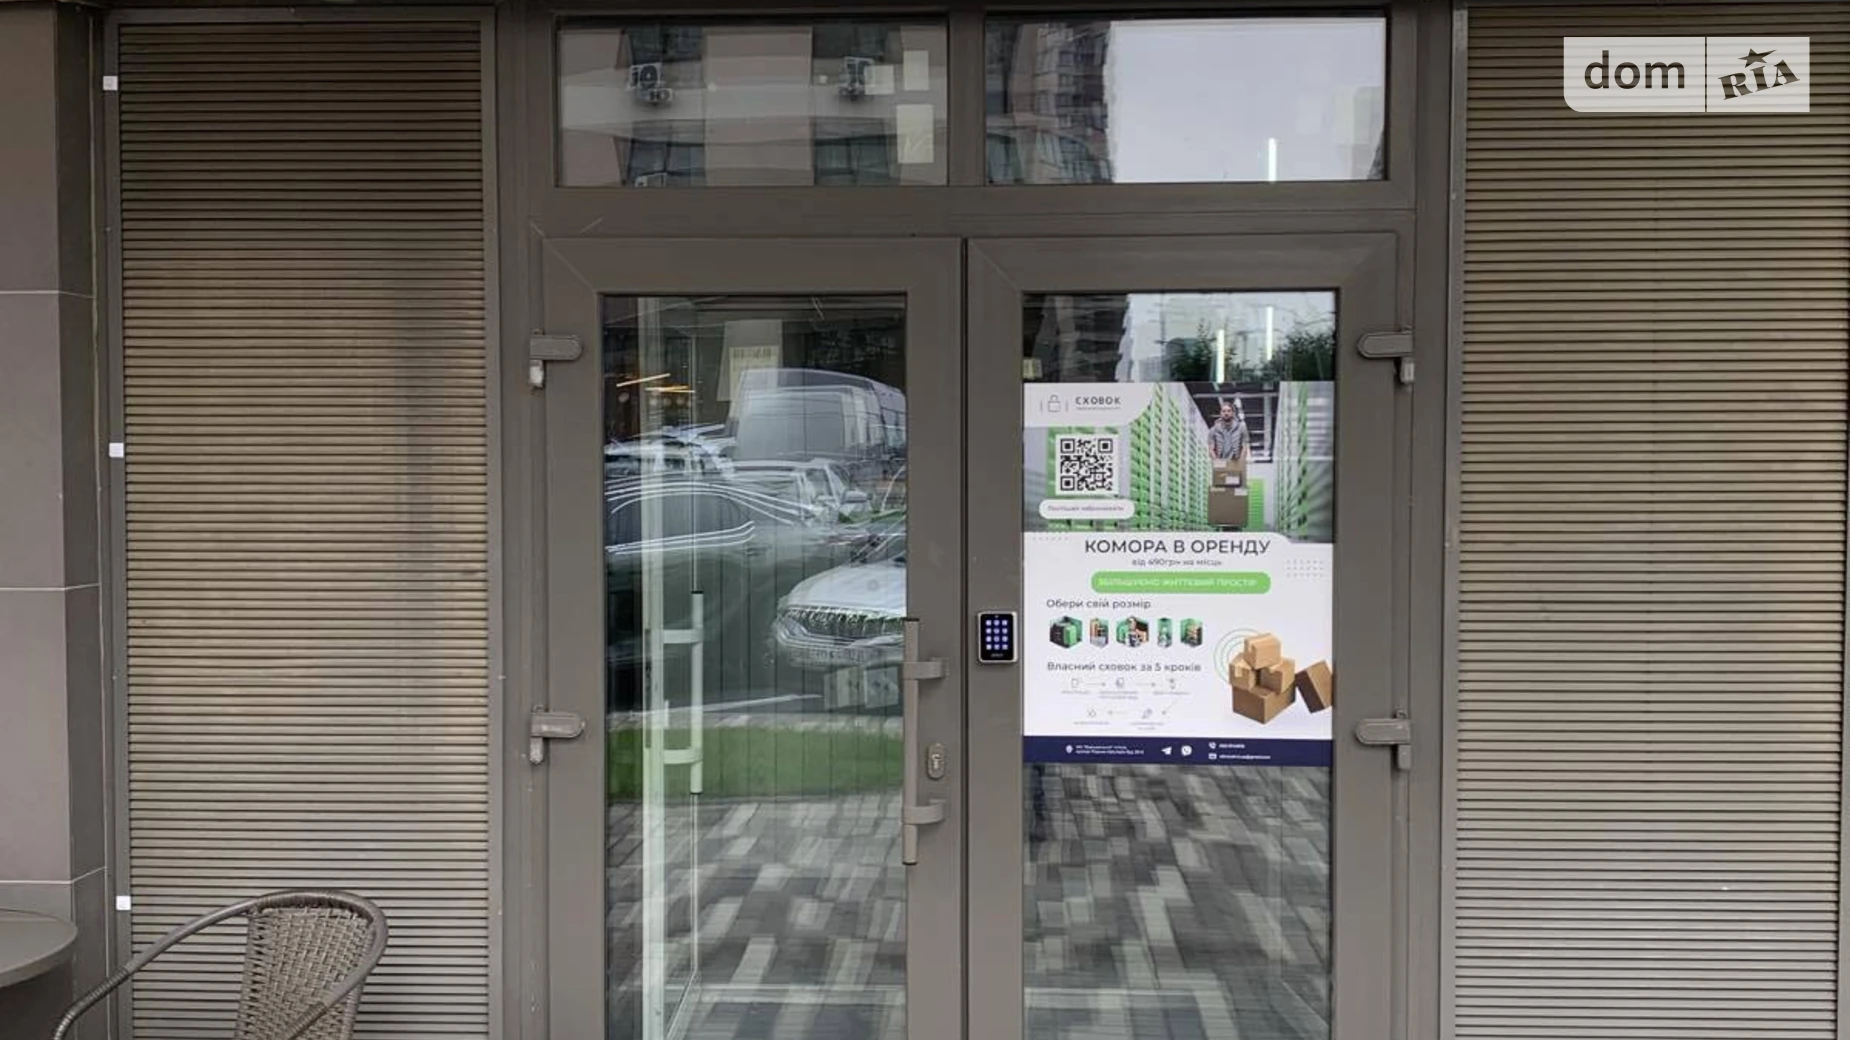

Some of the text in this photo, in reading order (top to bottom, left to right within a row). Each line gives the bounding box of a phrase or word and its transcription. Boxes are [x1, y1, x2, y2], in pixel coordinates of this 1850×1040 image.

[1075, 396, 1121, 405] СХОВОК
[1085, 539, 1271, 557] КОМОРА В ОРЕНДУ
[1046, 598, 1152, 611] Обери свій розмір
[1047, 661, 1202, 674] Власний сховок за 5 кроків
